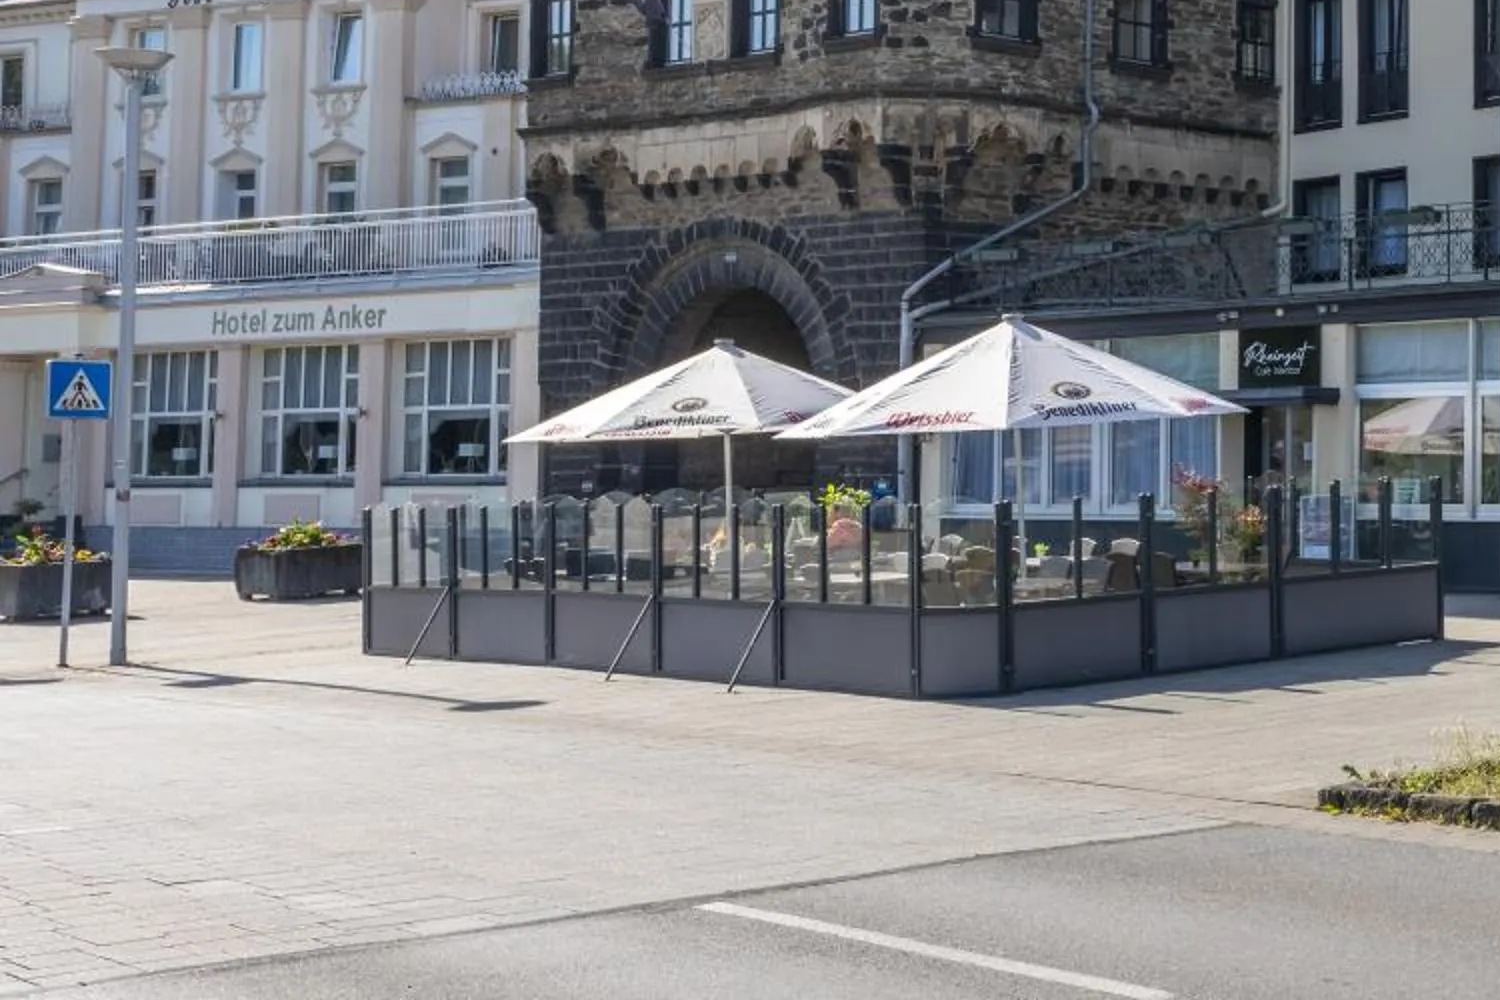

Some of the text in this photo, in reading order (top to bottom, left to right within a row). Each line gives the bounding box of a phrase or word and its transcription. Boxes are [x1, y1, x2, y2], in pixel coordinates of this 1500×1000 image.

[211, 304, 387, 336] Hotel zum Anker
[1243, 341, 1316, 368] Rheinzeit
[1032, 400, 1138, 421] Benediktiner
